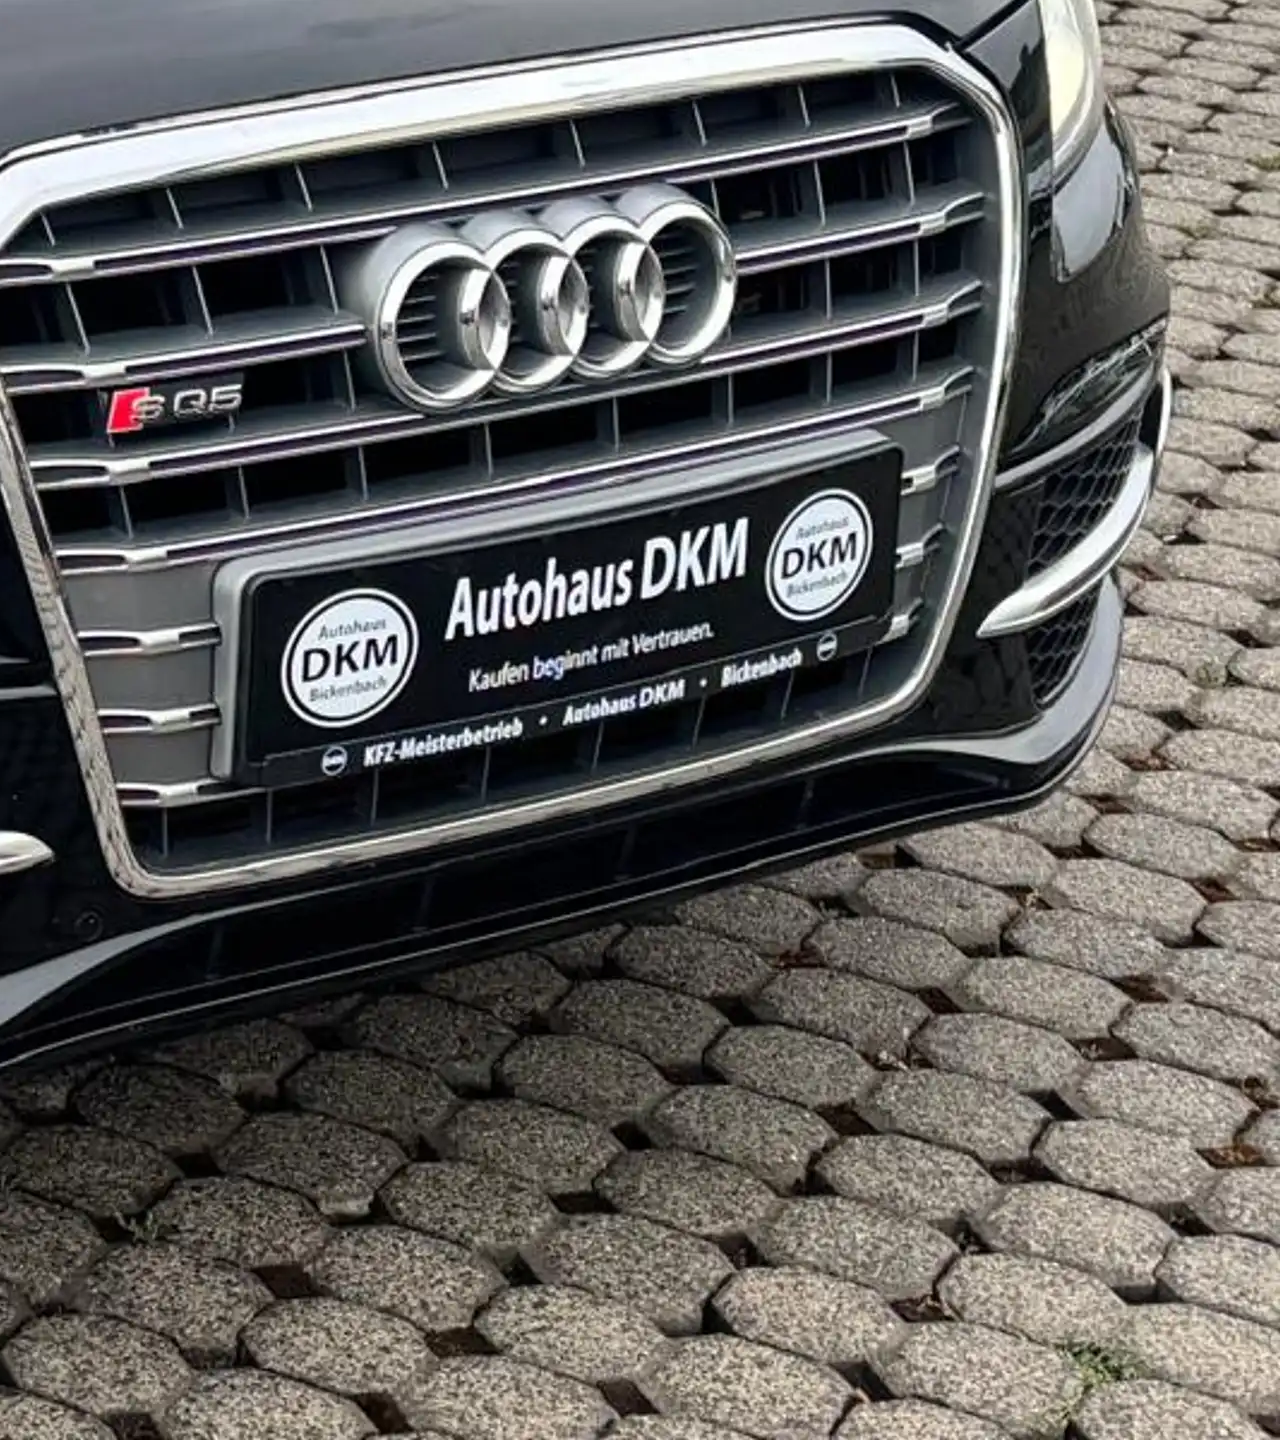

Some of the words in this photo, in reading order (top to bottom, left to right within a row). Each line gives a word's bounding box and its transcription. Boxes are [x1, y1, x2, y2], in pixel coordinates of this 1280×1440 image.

[444, 557, 634, 640] Autohaus
[640, 517, 749, 600] DKM
[781, 531, 858, 580] DKM
[301, 633, 398, 683] DKM
[318, 619, 386, 641] Autohaus
[468, 662, 529, 692] Kaufen
[532, 646, 598, 681] beginnt
[600, 639, 630, 663] mit
[632, 621, 716, 655] Vertrauen.
[363, 717, 524, 767] KFZ-Meisterbetrieb
[562, 693, 637, 726] Autohaus
[639, 678, 686, 709] DKM
[720, 645, 804, 688] Bickenbach
